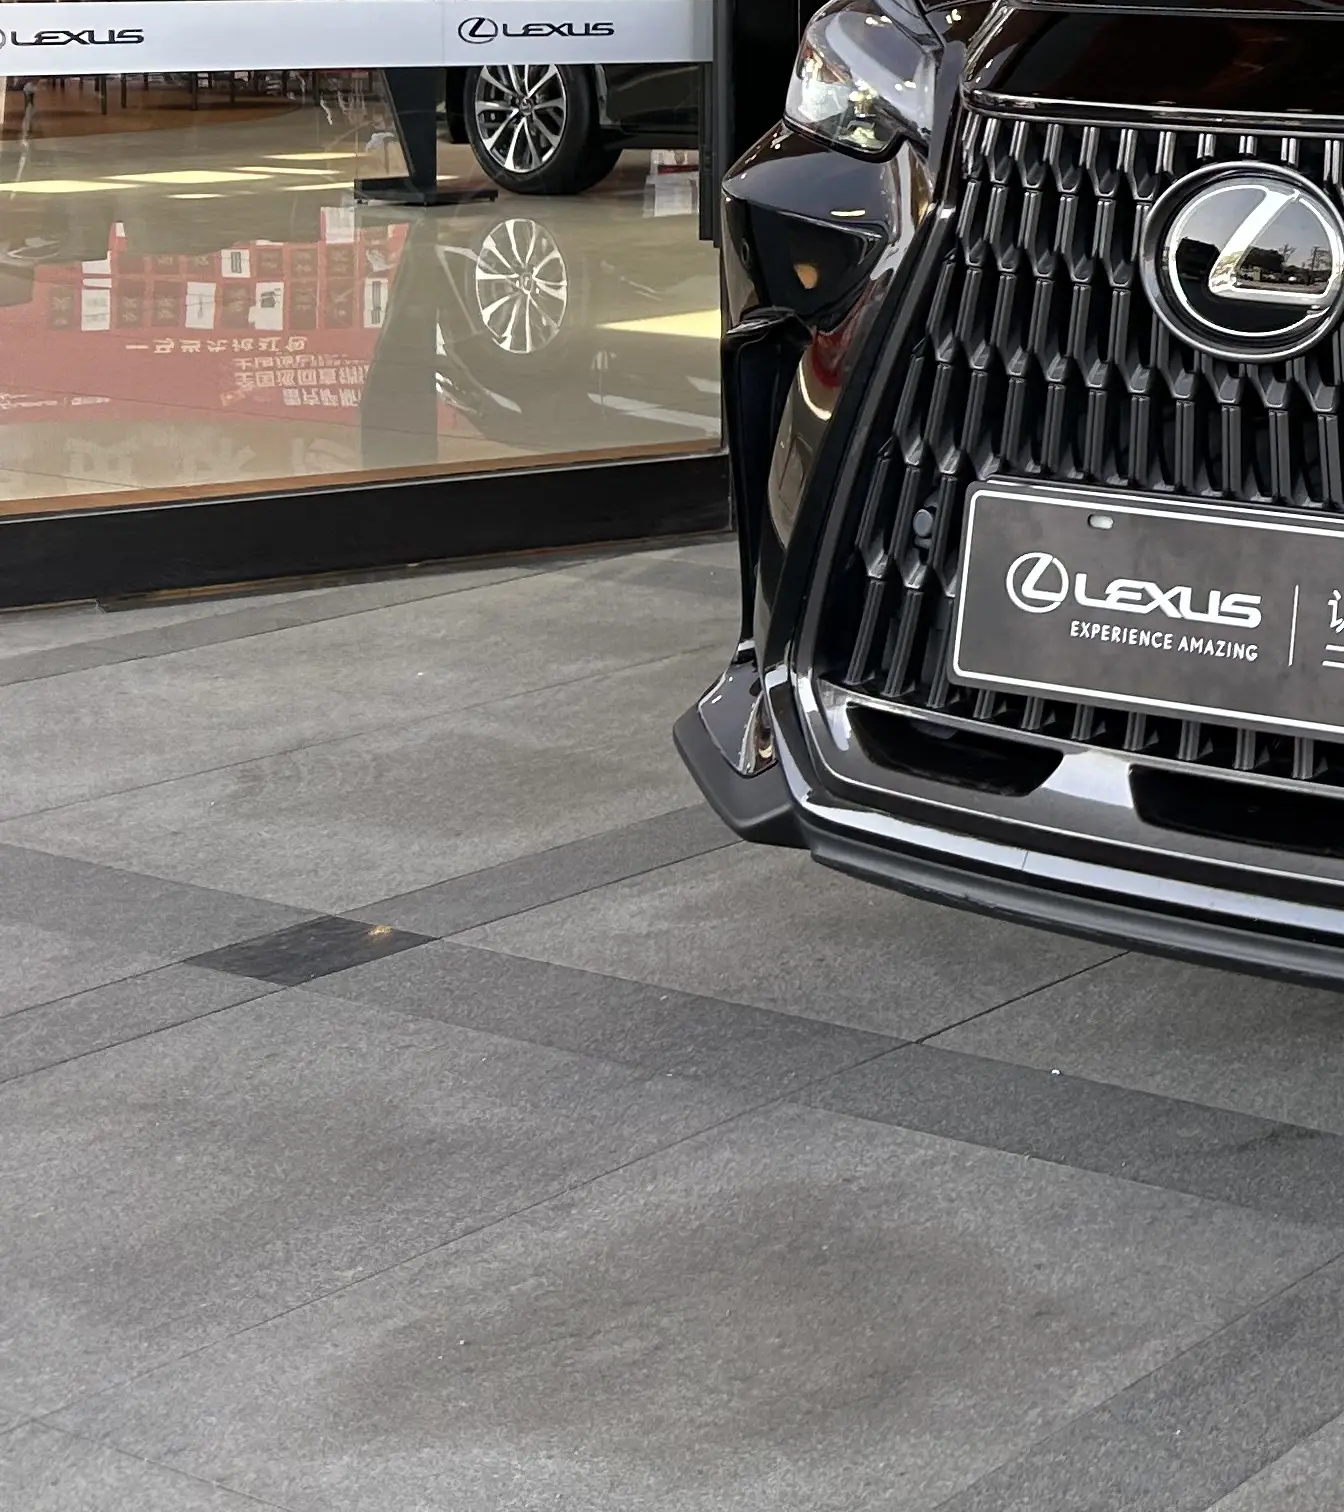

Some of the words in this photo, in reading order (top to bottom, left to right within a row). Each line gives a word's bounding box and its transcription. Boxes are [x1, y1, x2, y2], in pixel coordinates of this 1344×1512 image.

[11, 28, 145, 47] LEXUS
[502, 20, 614, 38] LEXUS
[1073, 571, 1263, 629] LEXUS
[1069, 619, 1173, 650] EXPERIENCE
[1178, 634, 1259, 662] AMAZING
